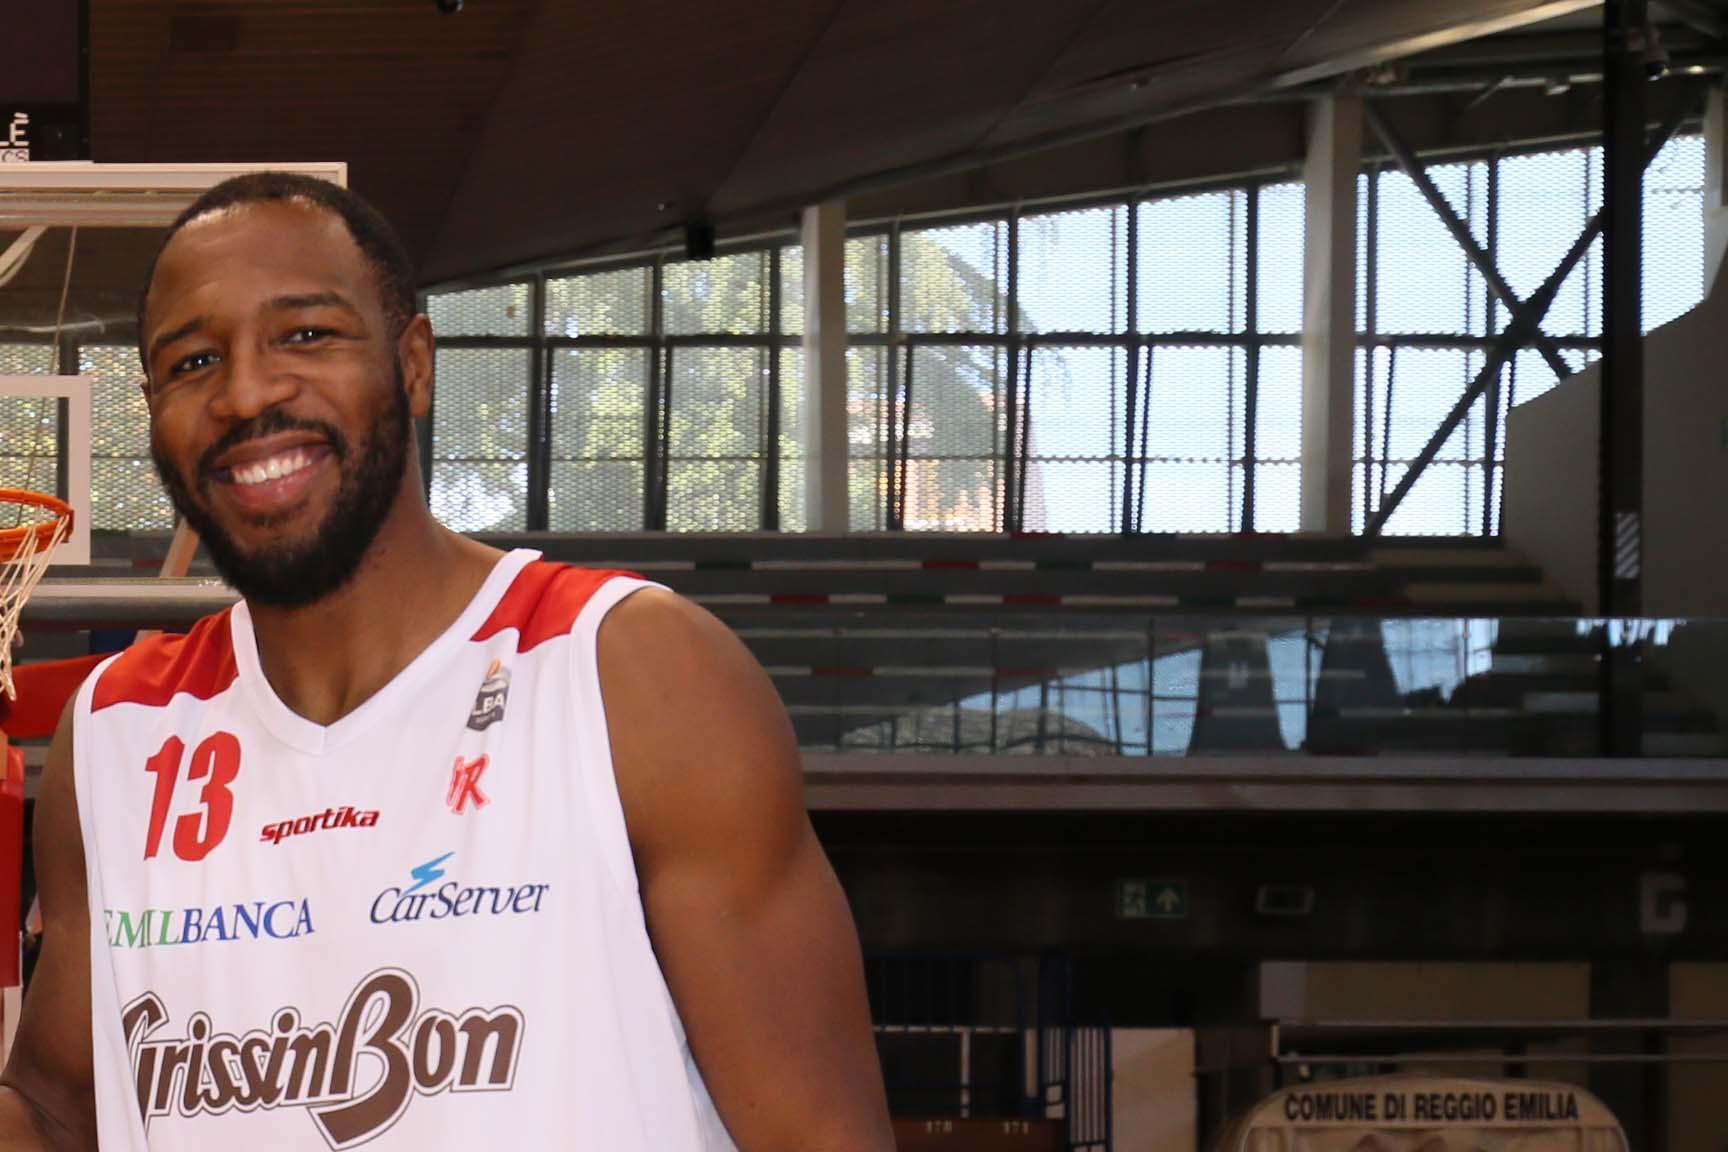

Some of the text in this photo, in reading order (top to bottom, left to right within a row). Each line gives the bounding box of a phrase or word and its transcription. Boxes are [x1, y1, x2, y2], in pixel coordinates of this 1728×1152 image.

[144, 731, 241, 861] 13
[260, 805, 379, 844] sportika
[371, 880, 550, 924] CarServer
[1284, 1093, 1579, 1121] COMUNE DI REGGIO EMILIA
